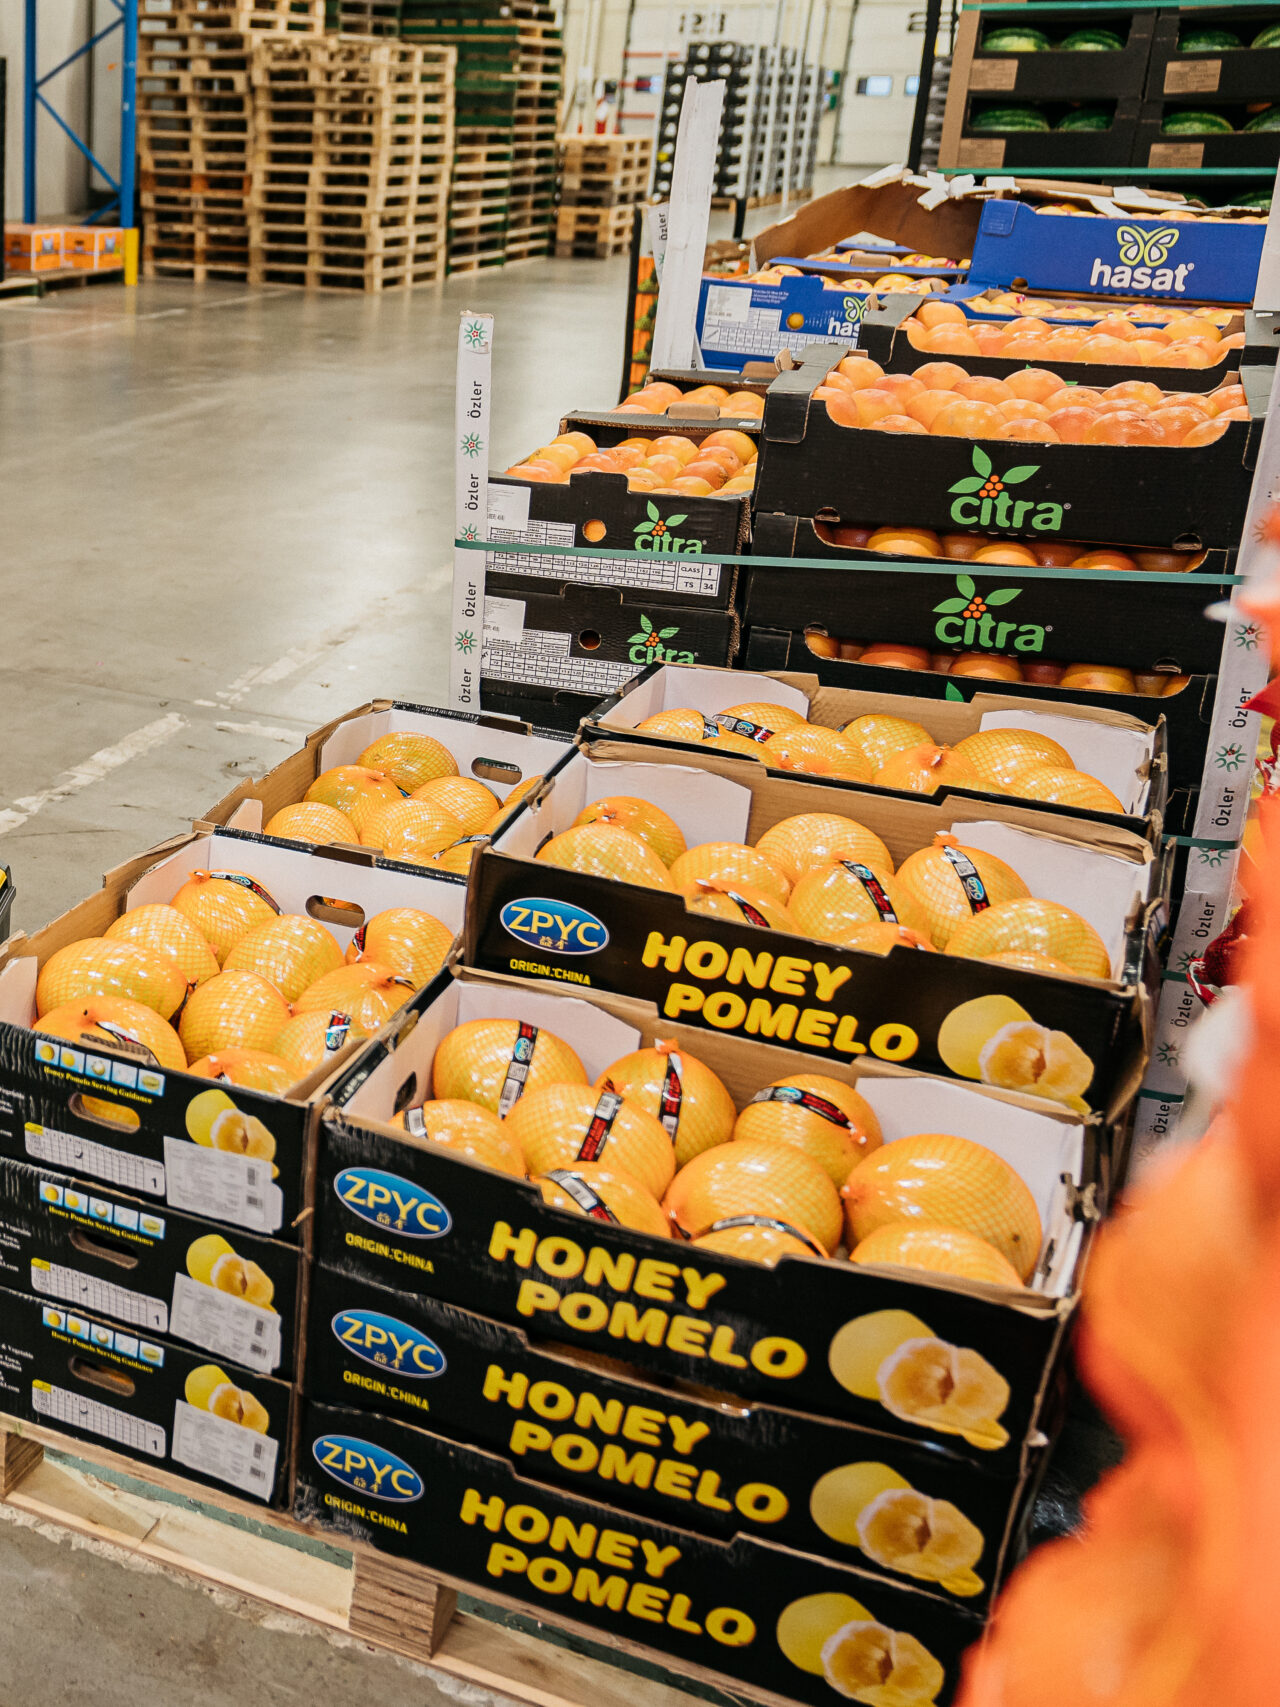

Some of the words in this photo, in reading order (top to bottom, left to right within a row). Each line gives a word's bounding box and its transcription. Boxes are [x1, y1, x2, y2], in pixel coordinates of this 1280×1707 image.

[1091, 257, 1189, 292] hasat
[827, 317, 861, 338] has
[466, 380, 483, 419] Özler
[464, 473, 480, 511] Özler
[951, 491, 1064, 531] citra
[634, 531, 703, 554] citra
[462, 582, 477, 617] Özler
[684, 581, 694, 589] TS
[703, 582, 714, 590] 34
[935, 612, 1045, 652] citra
[629, 643, 695, 665] citra
[459, 668, 472, 703] Özler
[1228, 687, 1253, 729] Özler
[1211, 786, 1236, 827] Özler
[508, 905, 601, 948] ZPYC
[1190, 901, 1216, 938] Özler
[642, 931, 853, 1001] HONEY
[663, 982, 919, 1062] POMELO
[1170, 990, 1195, 1028] Özler
[1149, 1103, 1170, 1134] Özle
[343, 1174, 442, 1232] ZPYC
[489, 1221, 726, 1309] HONEY
[341, 1316, 437, 1372] ZPYC
[516, 1279, 807, 1378] POMELO
[483, 1364, 710, 1454] HONEY
[321, 1440, 415, 1496] ZPYC
[509, 1419, 788, 1522] POMELO
[461, 1488, 681, 1577] HONEY
[486, 1542, 756, 1646] POMELO
